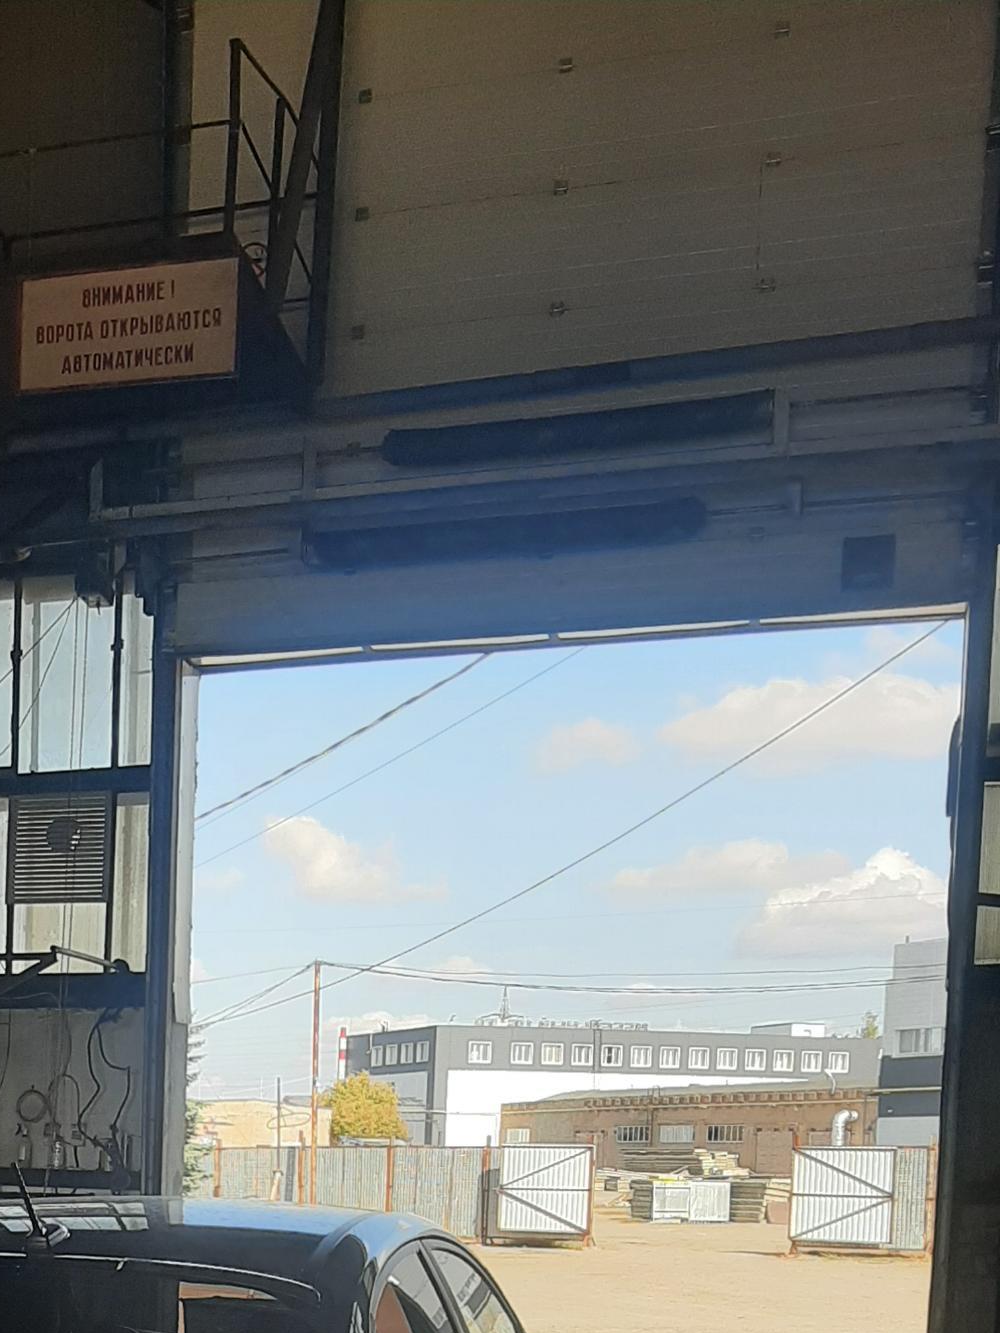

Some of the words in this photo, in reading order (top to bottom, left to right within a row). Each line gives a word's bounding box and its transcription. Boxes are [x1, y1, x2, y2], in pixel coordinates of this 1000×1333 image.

[36, 322, 93, 344] ВОРОТА
[100, 307, 222, 339] ОТКРЫВАЮТСЯ
[61, 343, 194, 374] АВТОМАТИЧЕСКИ
